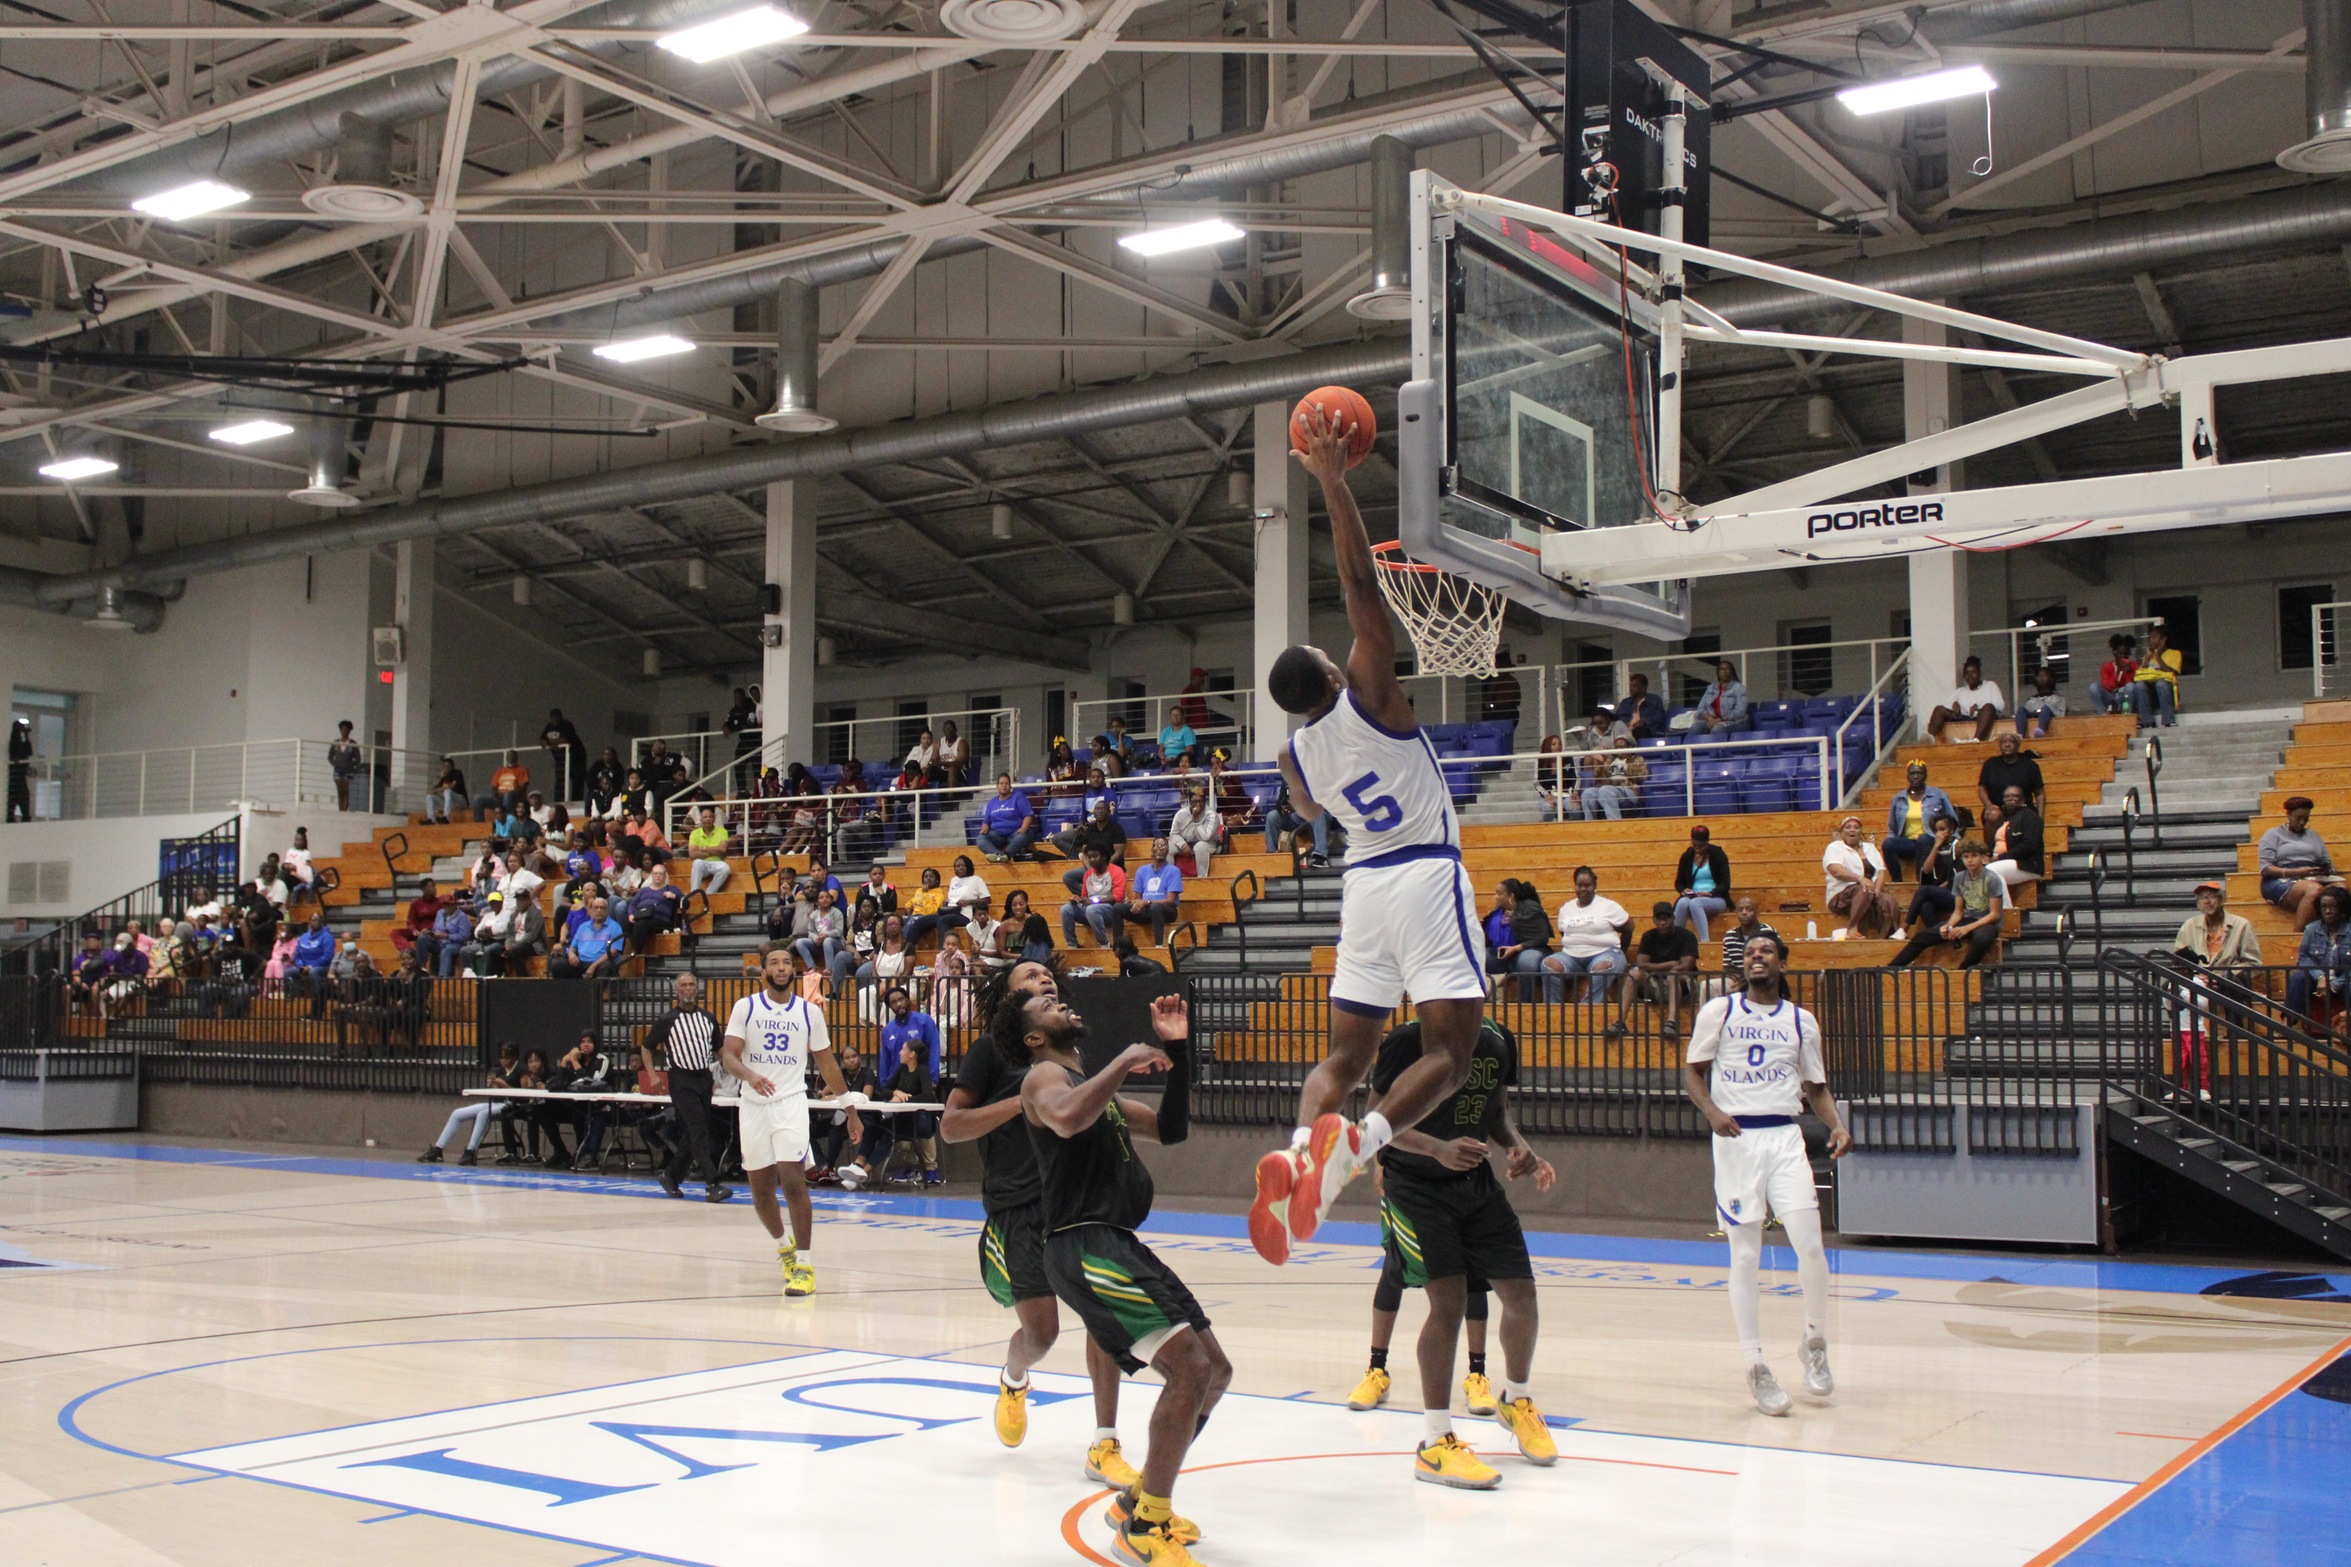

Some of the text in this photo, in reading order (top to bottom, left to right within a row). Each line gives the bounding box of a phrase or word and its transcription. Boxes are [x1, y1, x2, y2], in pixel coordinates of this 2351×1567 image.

[1626, 107, 1697, 169] DAKTRCS
[1341, 770, 1403, 832] 5
[755, 1019, 800, 1032] VIRGIN
[1727, 1026, 1789, 1043] VIRGIN
[763, 1032, 790, 1052] 33
[749, 1053, 798, 1065] ISLANDS
[1747, 1044, 1766, 1067] 0
[1454, 1094, 1488, 1125] 23
